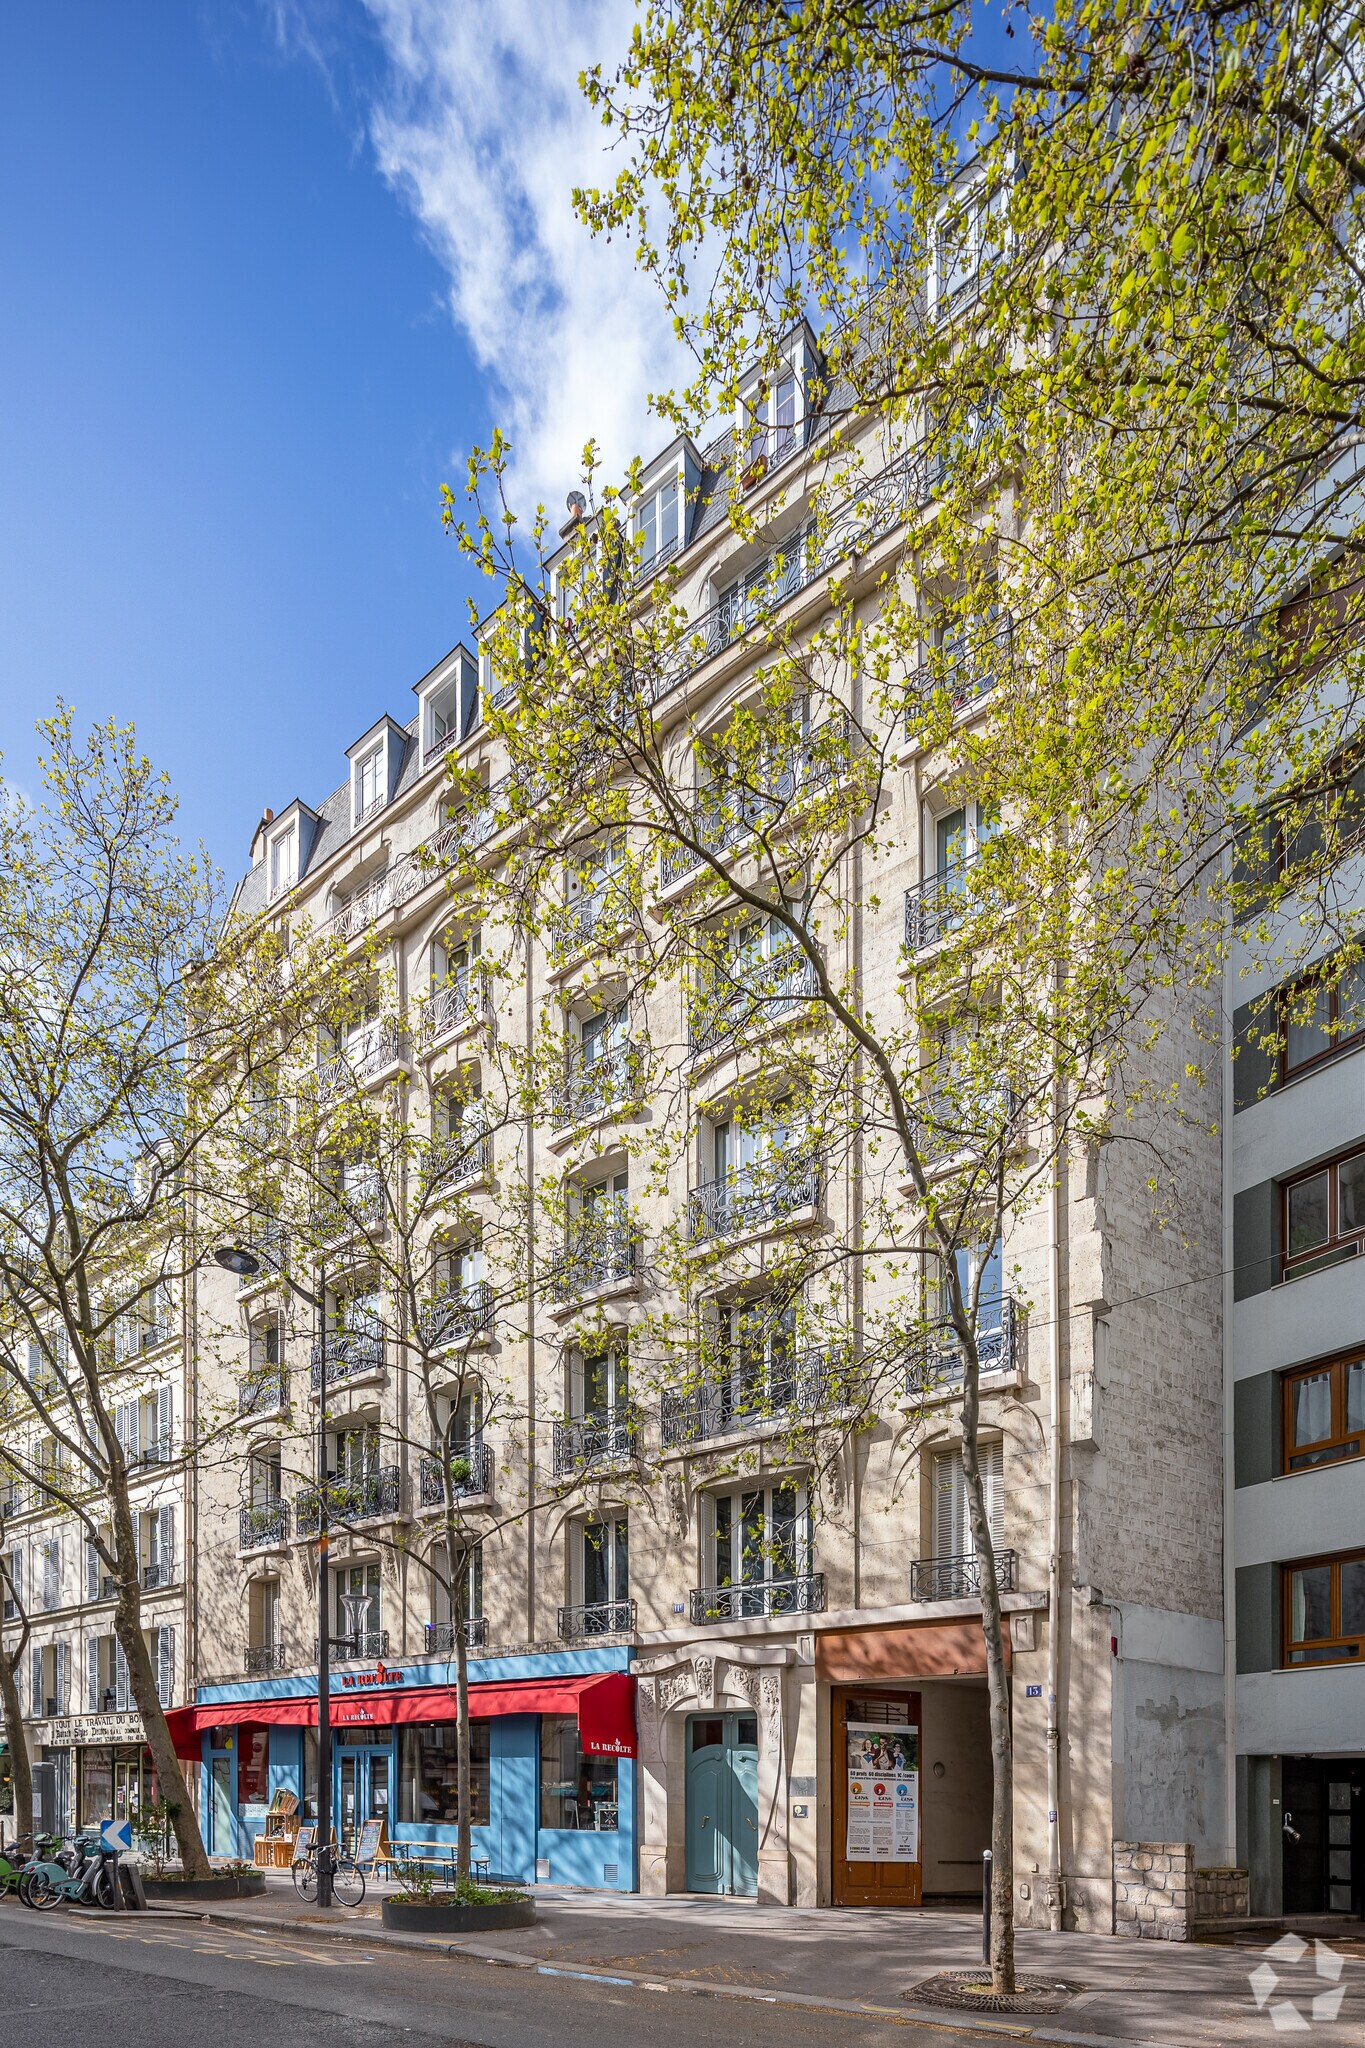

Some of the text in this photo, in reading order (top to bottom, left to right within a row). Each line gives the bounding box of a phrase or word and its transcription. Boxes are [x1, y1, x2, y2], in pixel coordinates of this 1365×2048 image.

[342, 1675, 354, 1686] LA
[1029, 1686, 1039, 1696] 13
[55, 1720, 71, 1729] TOUT
[74, 1719, 83, 1727] LE
[86, 1716, 113, 1727] TRAVAIL
[116, 1715, 126, 1724] DU
[590, 1741, 600, 1750] LA
